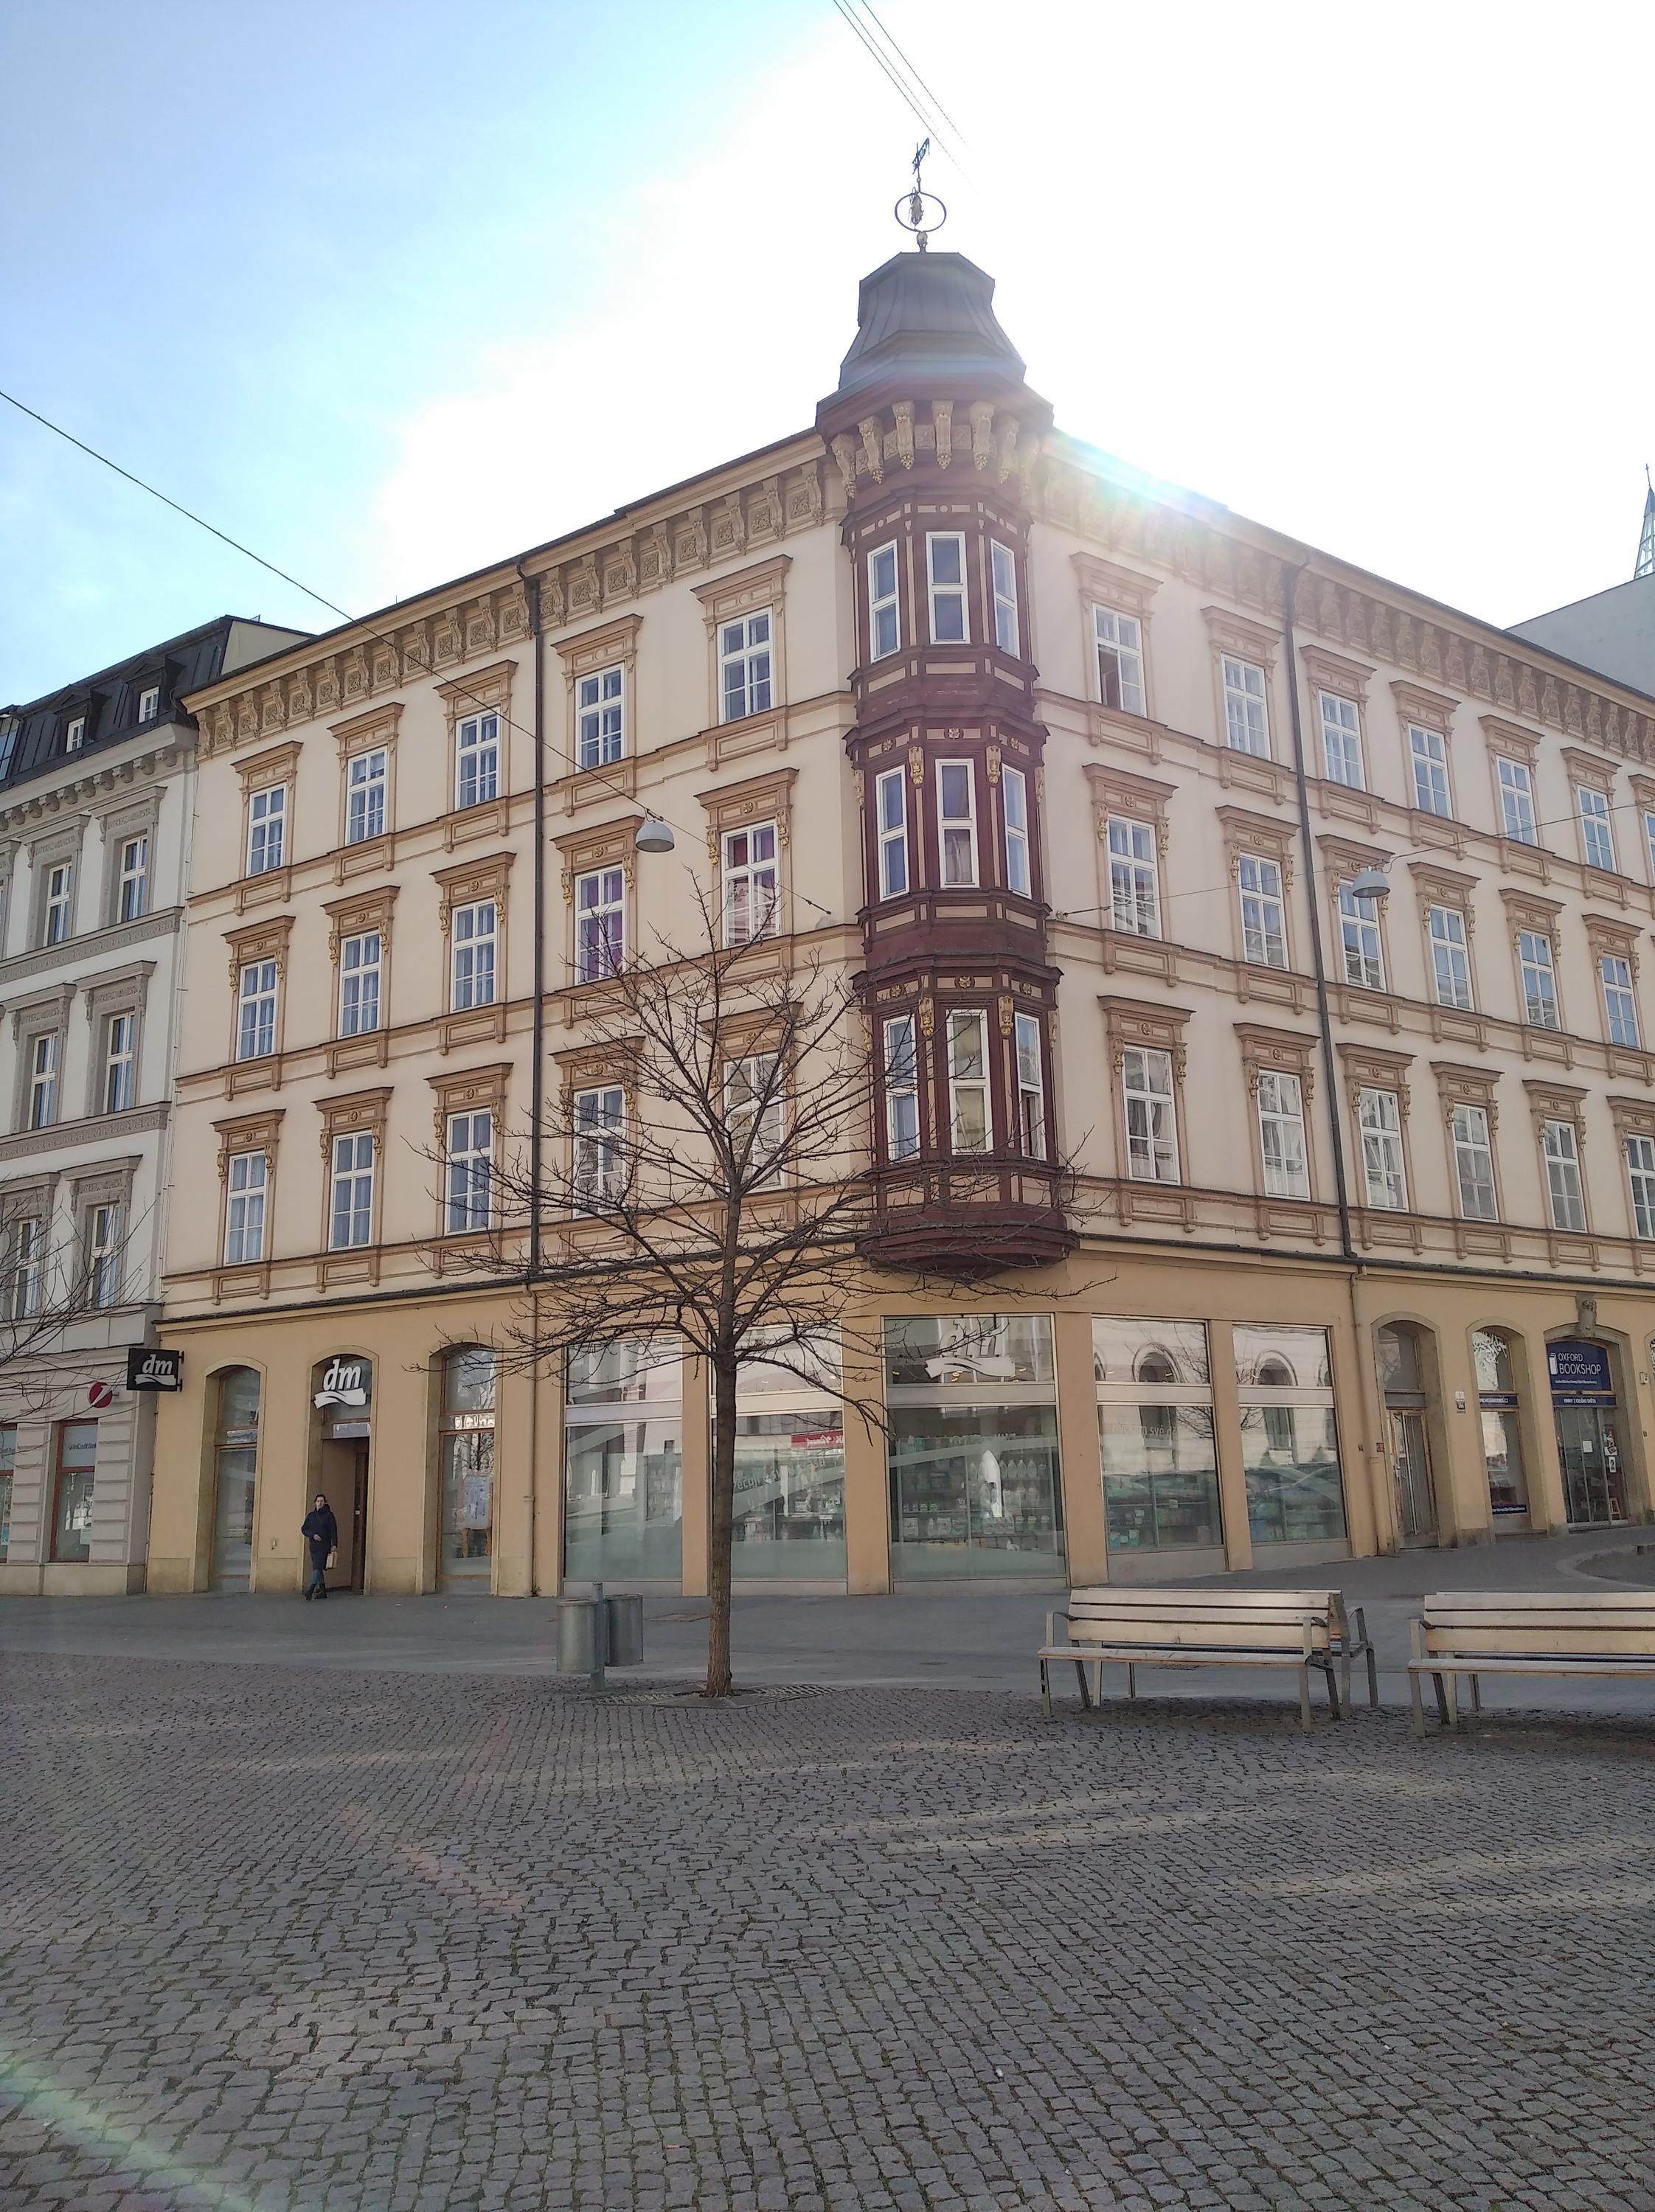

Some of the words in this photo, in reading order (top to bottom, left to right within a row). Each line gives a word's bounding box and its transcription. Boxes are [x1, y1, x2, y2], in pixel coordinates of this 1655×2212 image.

[142, 1354, 173, 1374] dm
[1558, 1353, 1583, 1362] OXFORD
[323, 1358, 361, 1391] dm
[1559, 1363, 1601, 1375] BOOKSHOP
